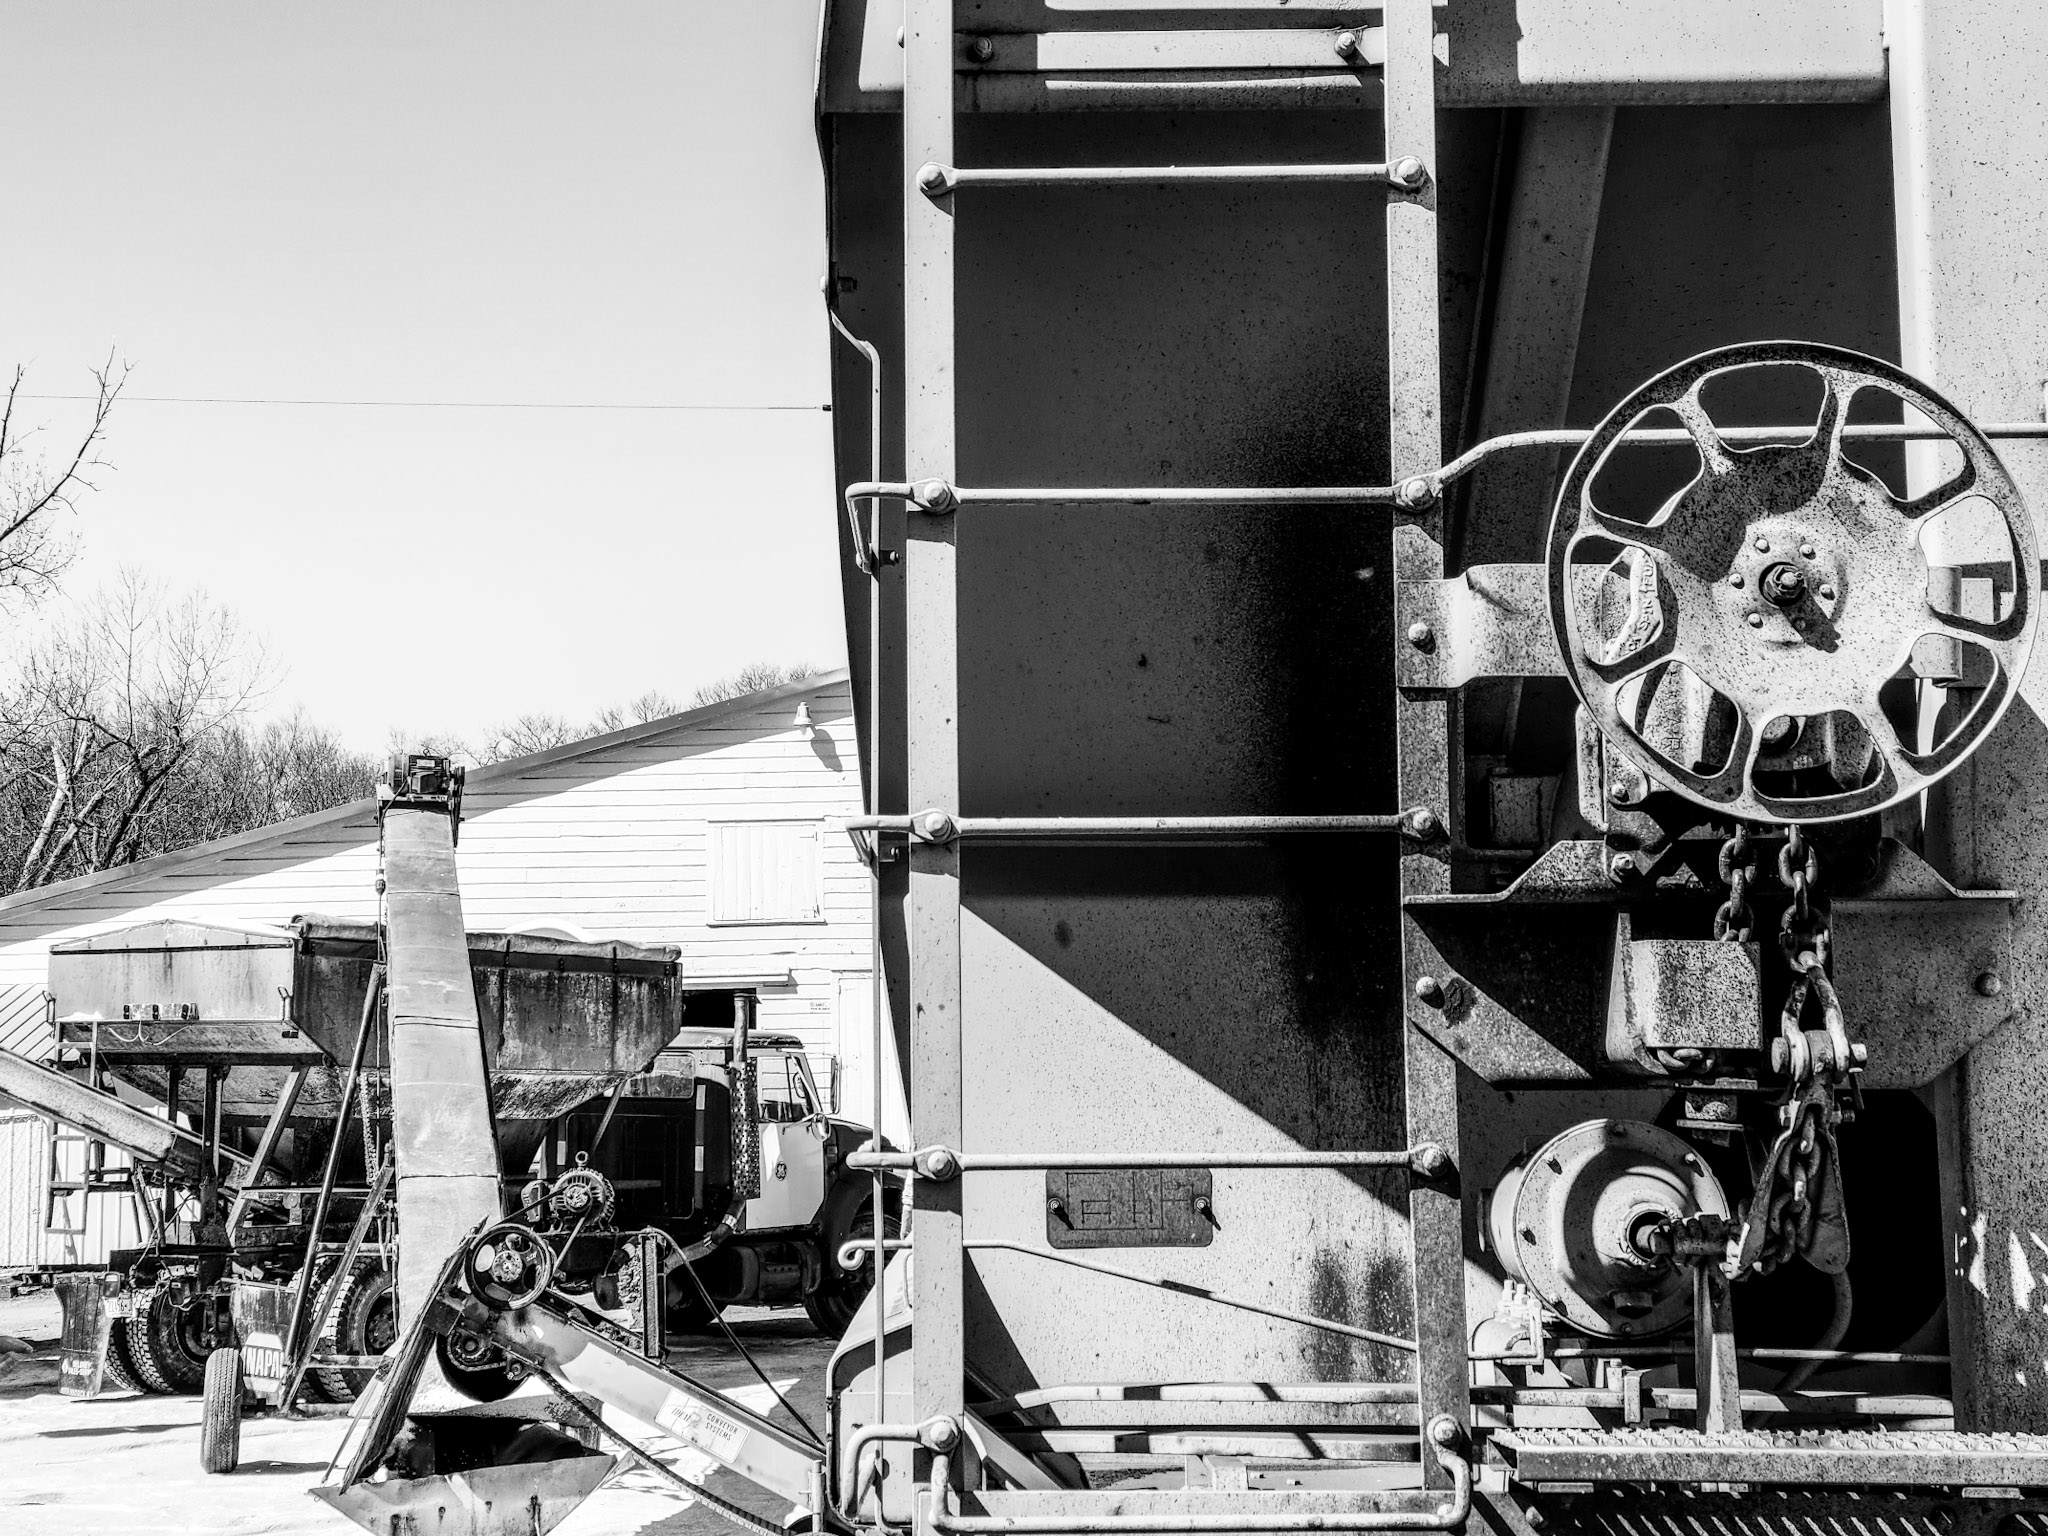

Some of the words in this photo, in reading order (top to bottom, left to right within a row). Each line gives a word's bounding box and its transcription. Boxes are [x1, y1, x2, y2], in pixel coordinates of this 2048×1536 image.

[246, 1346, 280, 1379] NAPA
[705, 1422, 732, 1441] SYSTEMS
[706, 1413, 738, 1434] CONVEYOR
